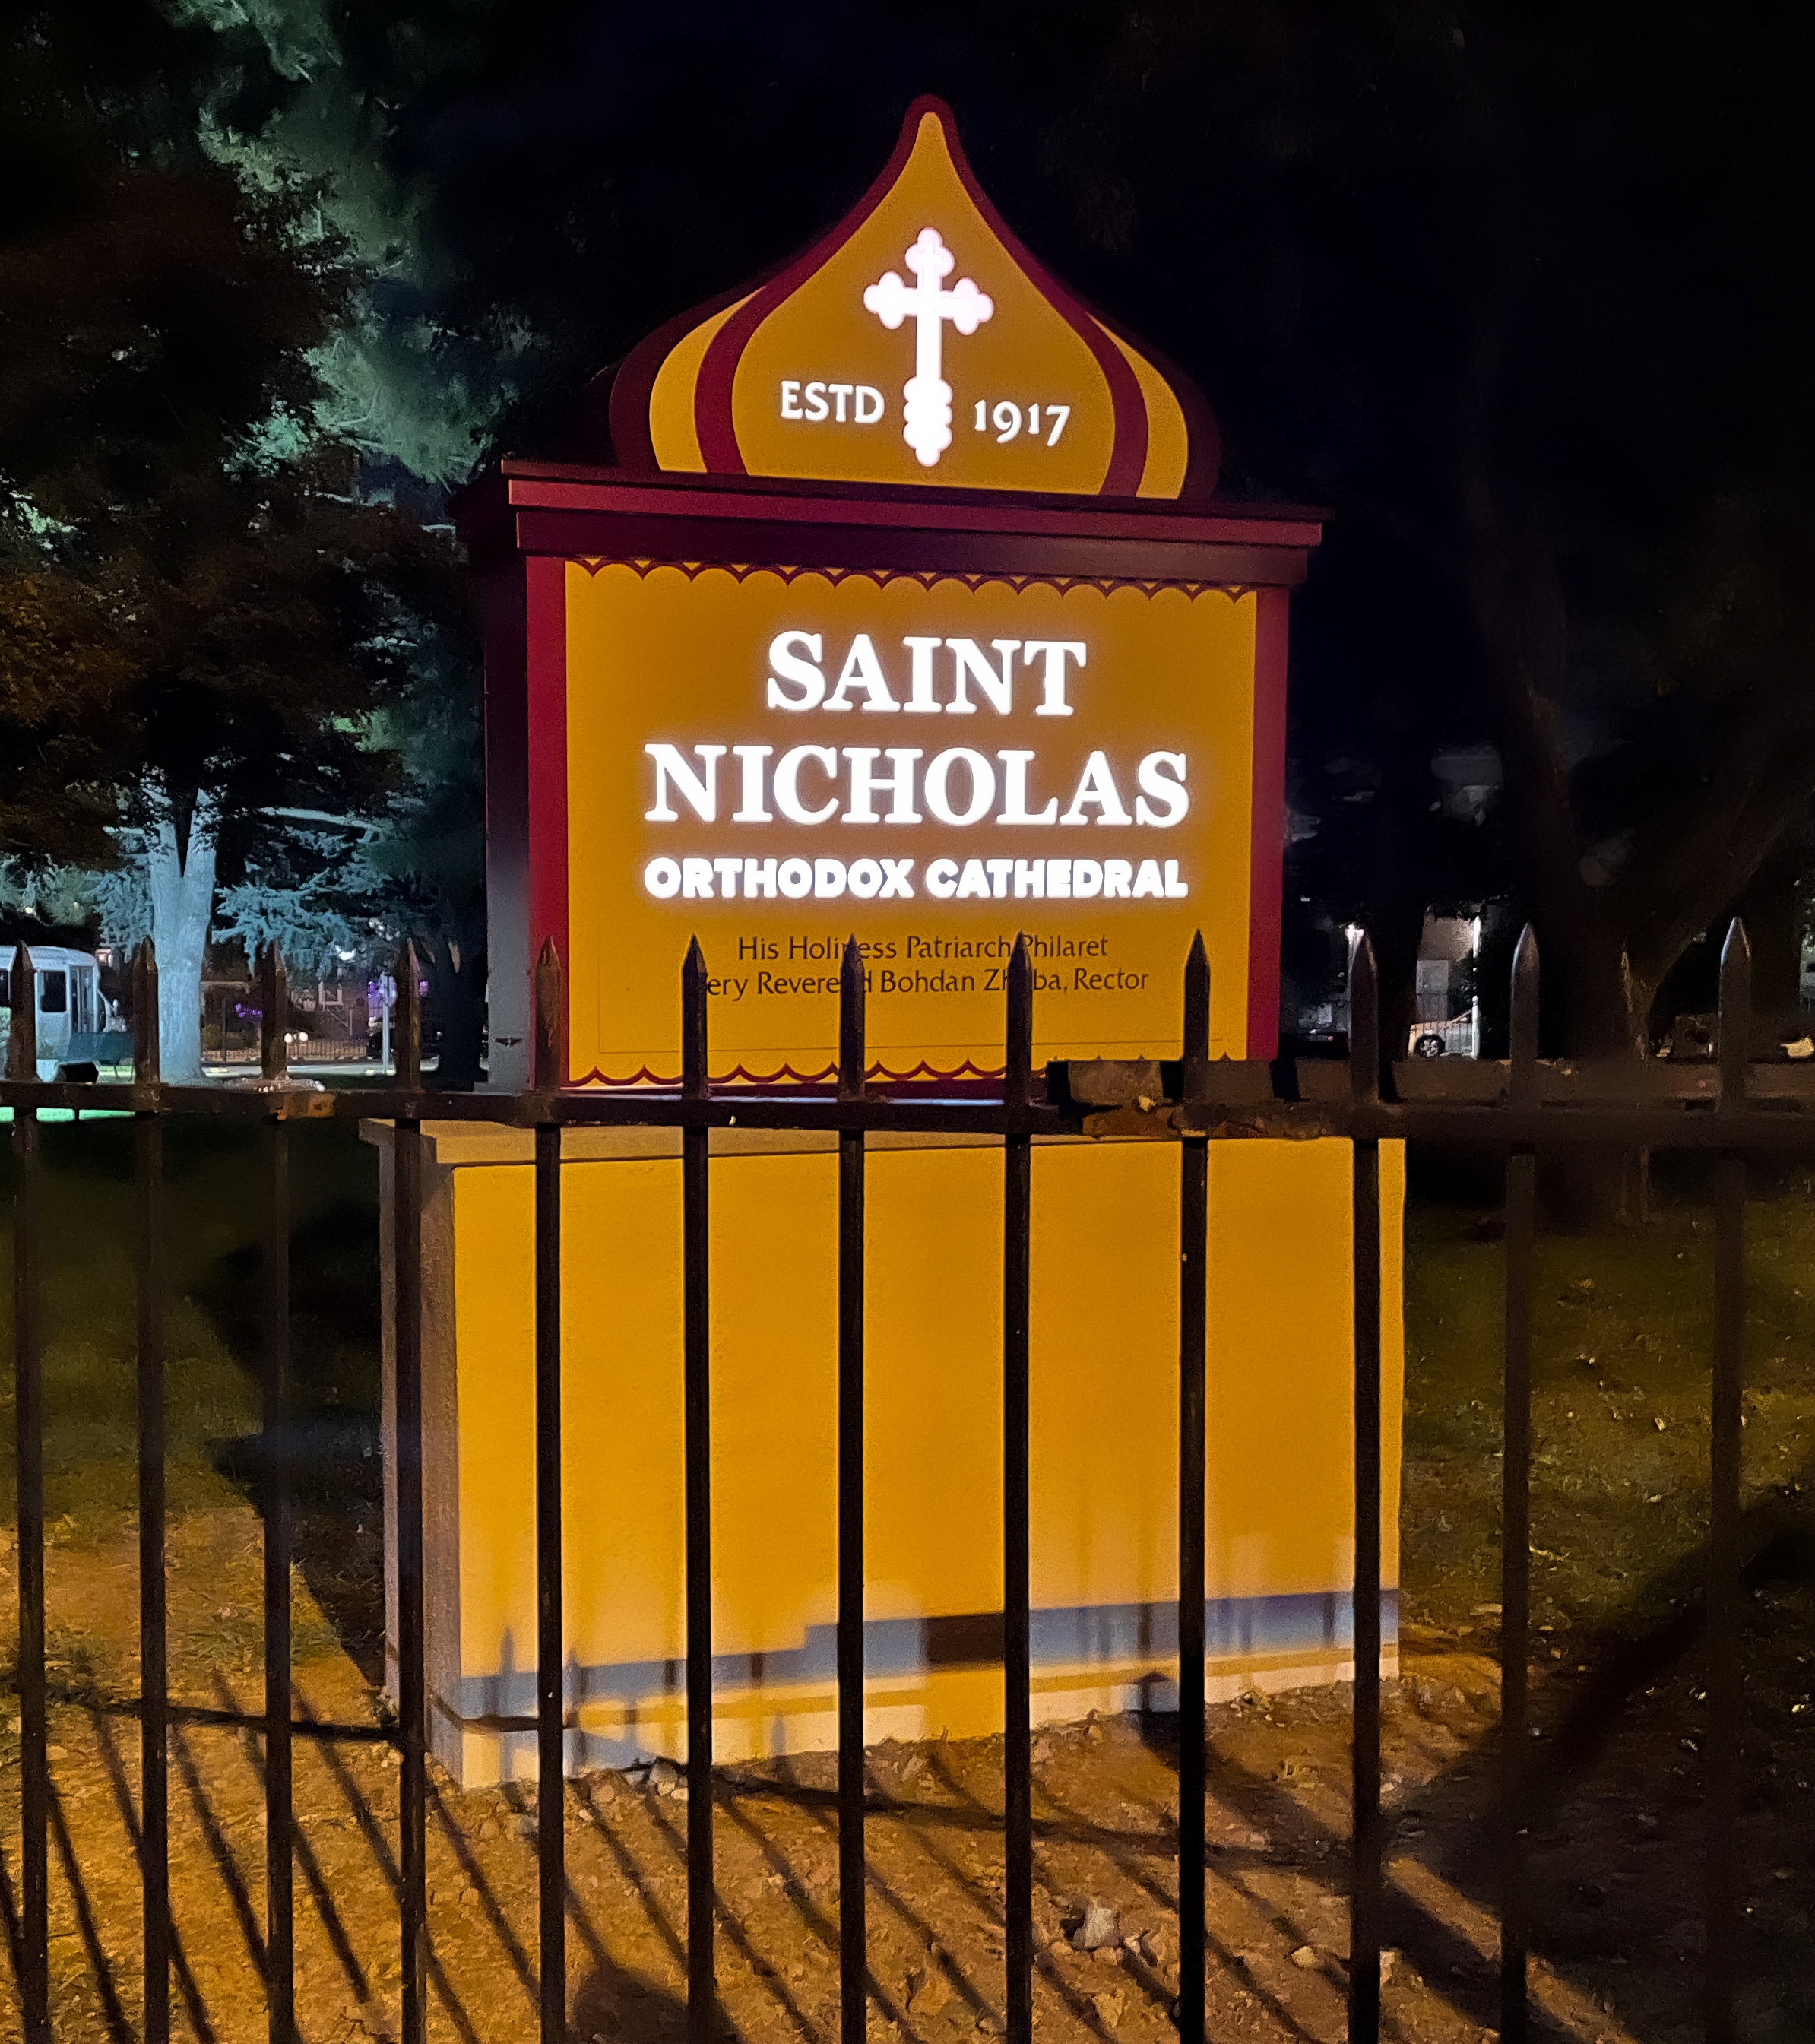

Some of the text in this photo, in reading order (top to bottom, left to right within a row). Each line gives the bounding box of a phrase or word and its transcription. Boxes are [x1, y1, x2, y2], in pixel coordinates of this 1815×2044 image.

[781, 380, 1071, 446] ESTD 1917
[767, 630, 1086, 715] SAINT
[645, 743, 1190, 828] NICHOLAS
[644, 856, 1188, 899] ORTHODOX CATHEDRAL
[738, 936, 779, 960] His
[907, 935, 1011, 959] Patriarch
[695, 971, 749, 1002] ery
[757, 971, 872, 995] Revered
[880, 969, 975, 993] Bohdan
[1073, 967, 1149, 990] Rector
